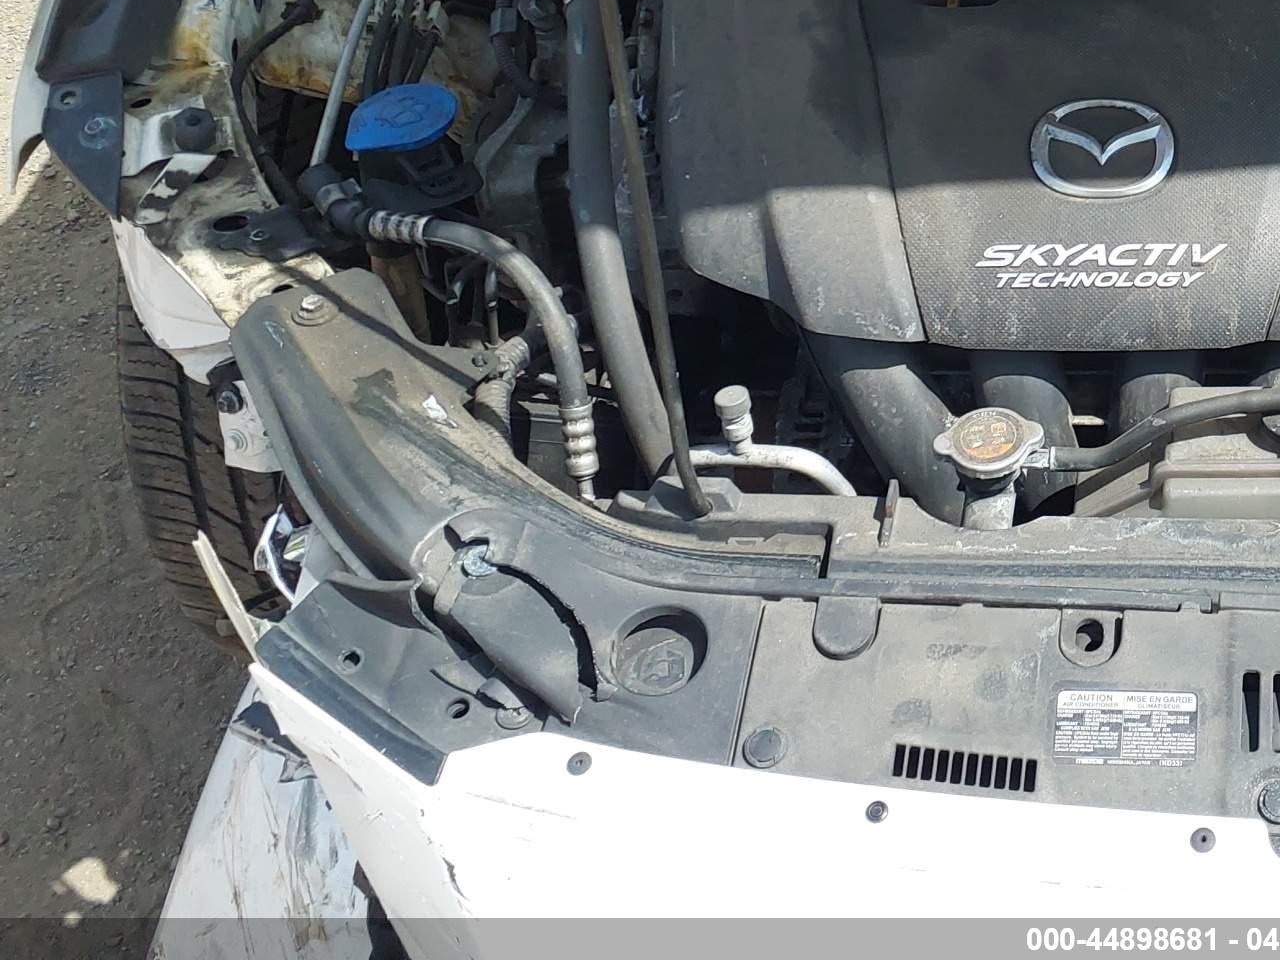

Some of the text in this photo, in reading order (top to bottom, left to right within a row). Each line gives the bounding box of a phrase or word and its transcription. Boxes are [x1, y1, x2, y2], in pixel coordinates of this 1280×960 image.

[974, 243, 1228, 267] SKYACTIV
[996, 271, 1206, 288] TECHNOLOGY
[1070, 693, 1113, 702] CAUTION
[1126, 695, 1147, 703] MISE
[1163, 696, 1193, 704] GARDE
